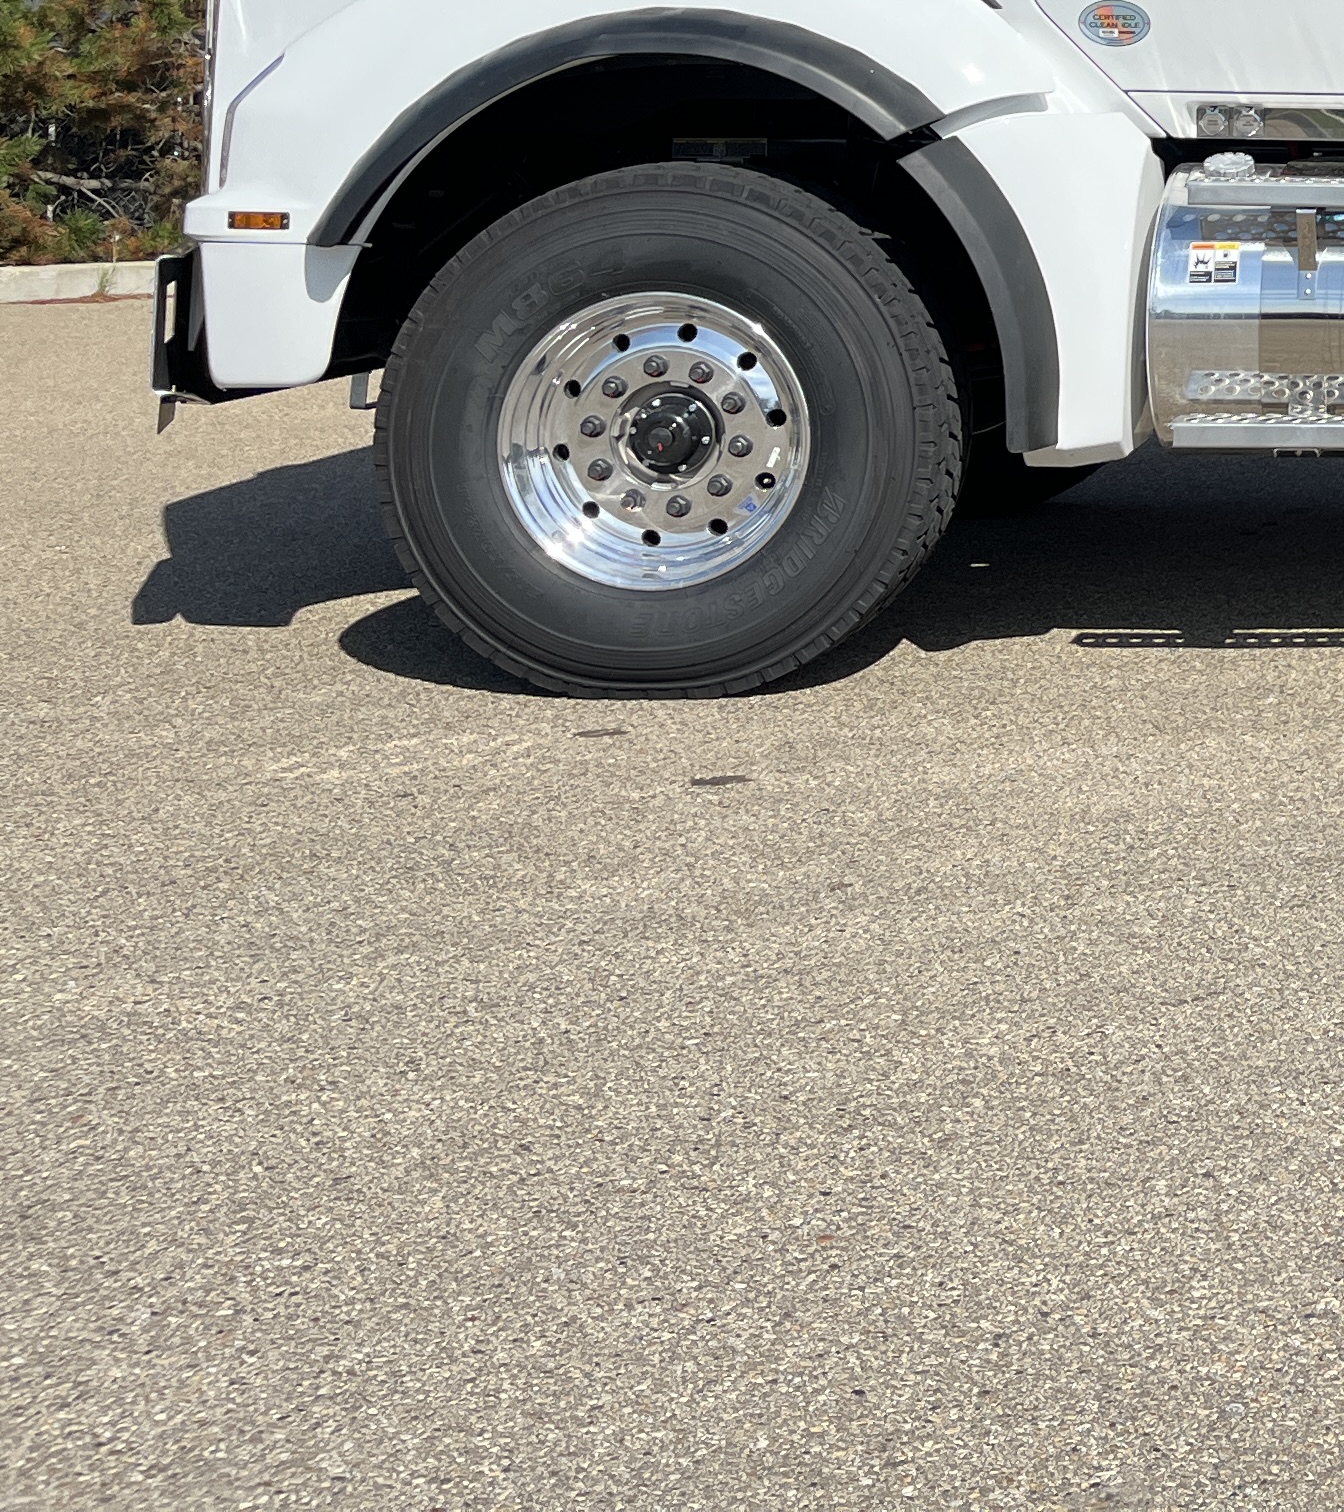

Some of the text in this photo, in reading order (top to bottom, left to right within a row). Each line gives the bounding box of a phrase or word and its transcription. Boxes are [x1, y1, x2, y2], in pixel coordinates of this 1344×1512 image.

[1088, 21, 1118, 29] CLEAN
[474, 248, 626, 364] M864
[629, 485, 847, 637] BRIDGESTONE
